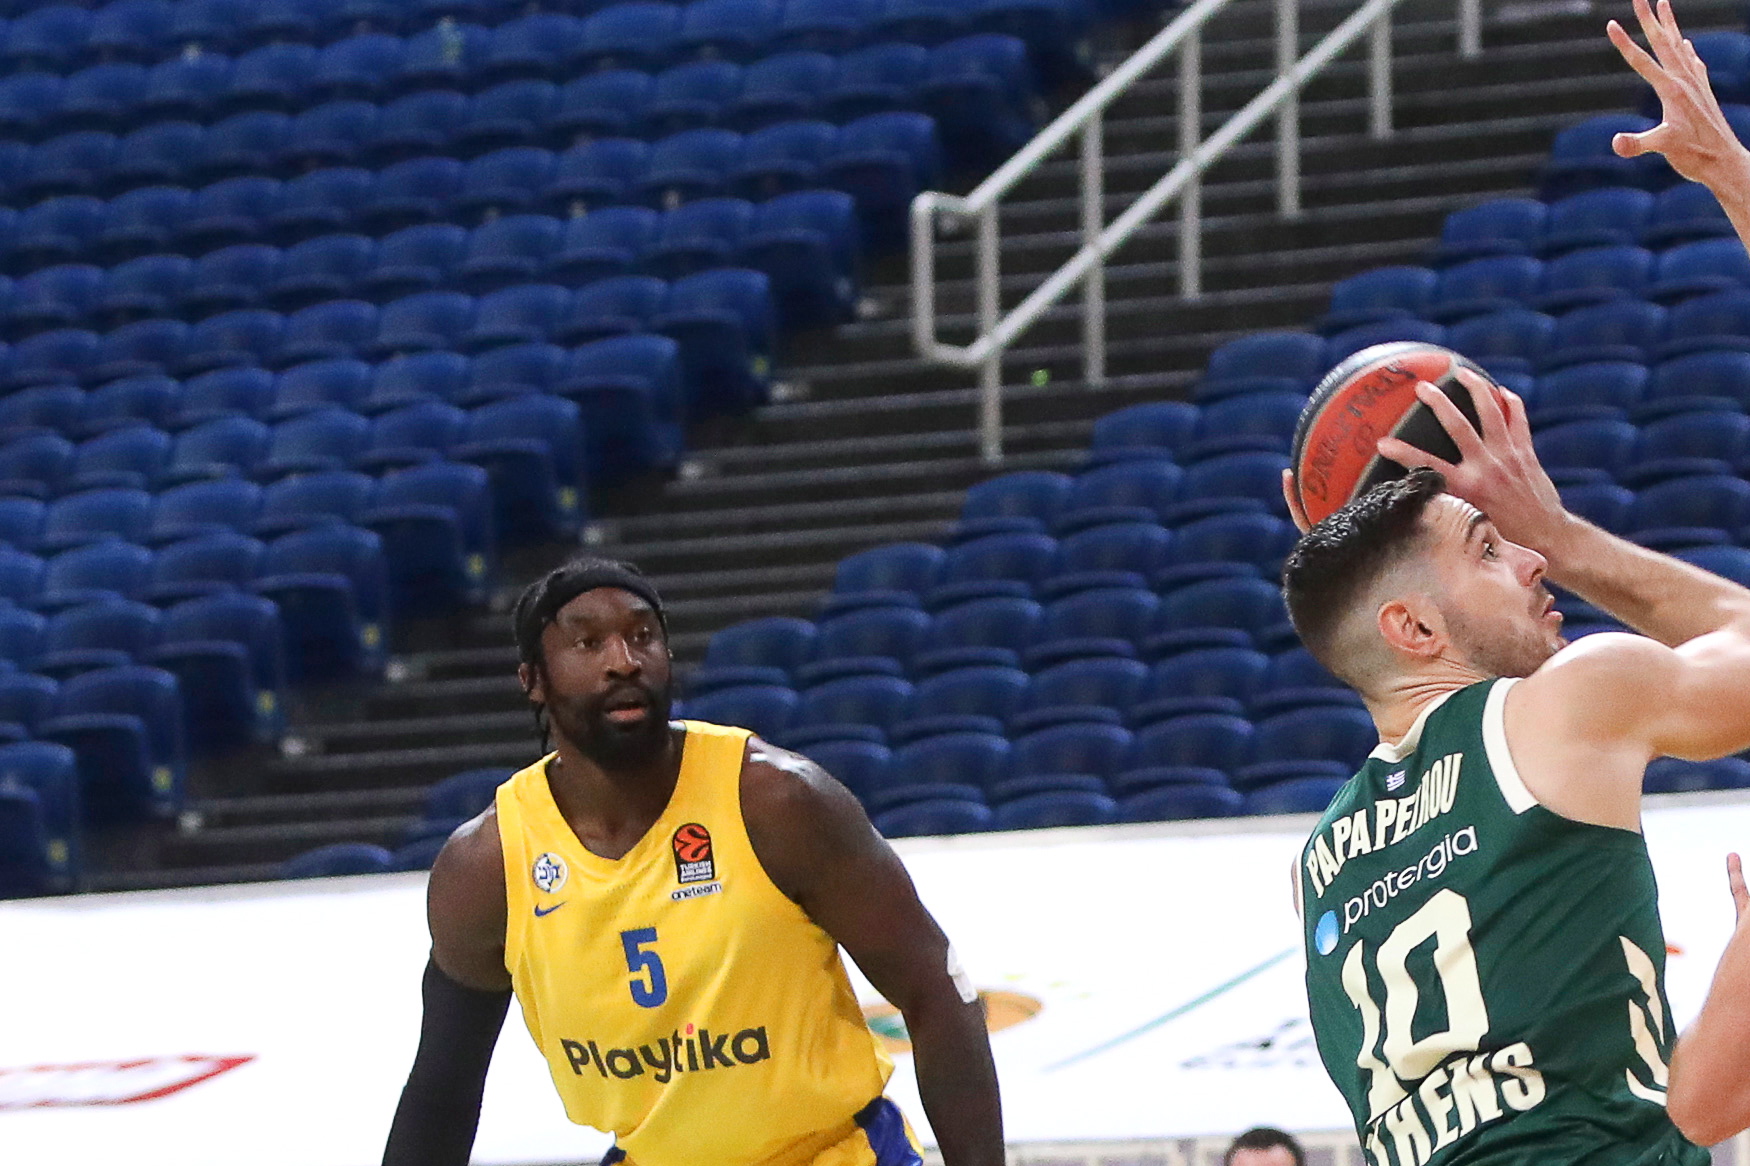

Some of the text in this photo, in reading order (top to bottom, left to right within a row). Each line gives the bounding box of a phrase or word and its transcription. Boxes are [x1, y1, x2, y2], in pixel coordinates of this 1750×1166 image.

[1343, 825, 1479, 934] protergia
[619, 926, 668, 1009] 5
[1340, 887, 1490, 1125] 10
[561, 1022, 771, 1083] Playtika
